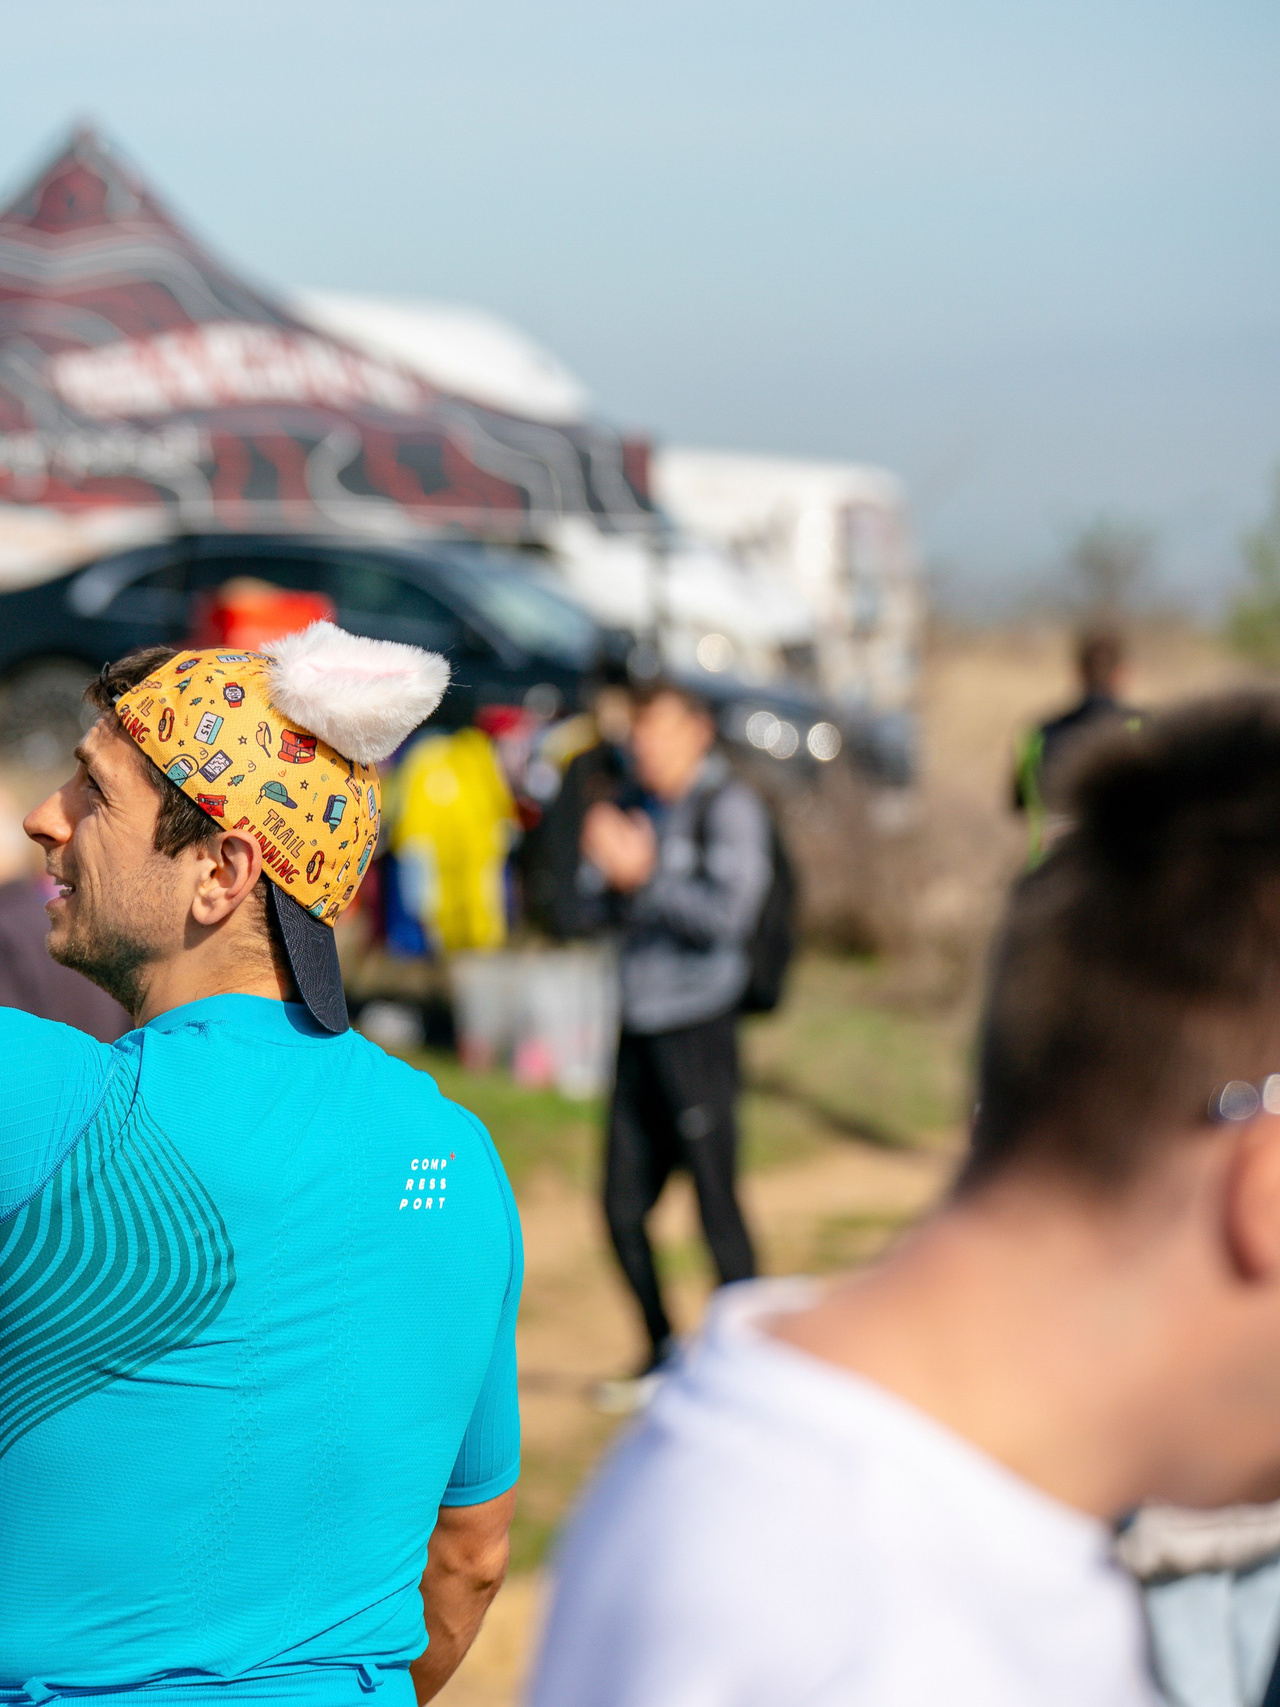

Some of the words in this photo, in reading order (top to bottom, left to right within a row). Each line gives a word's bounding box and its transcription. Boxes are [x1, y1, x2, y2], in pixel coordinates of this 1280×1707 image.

[201, 719, 214, 736] 145
[263, 809, 305, 859] TRAiL
[411, 1158, 447, 1171] COMP
[405, 1178, 447, 1191] RESS
[399, 1197, 445, 1210] PORT
